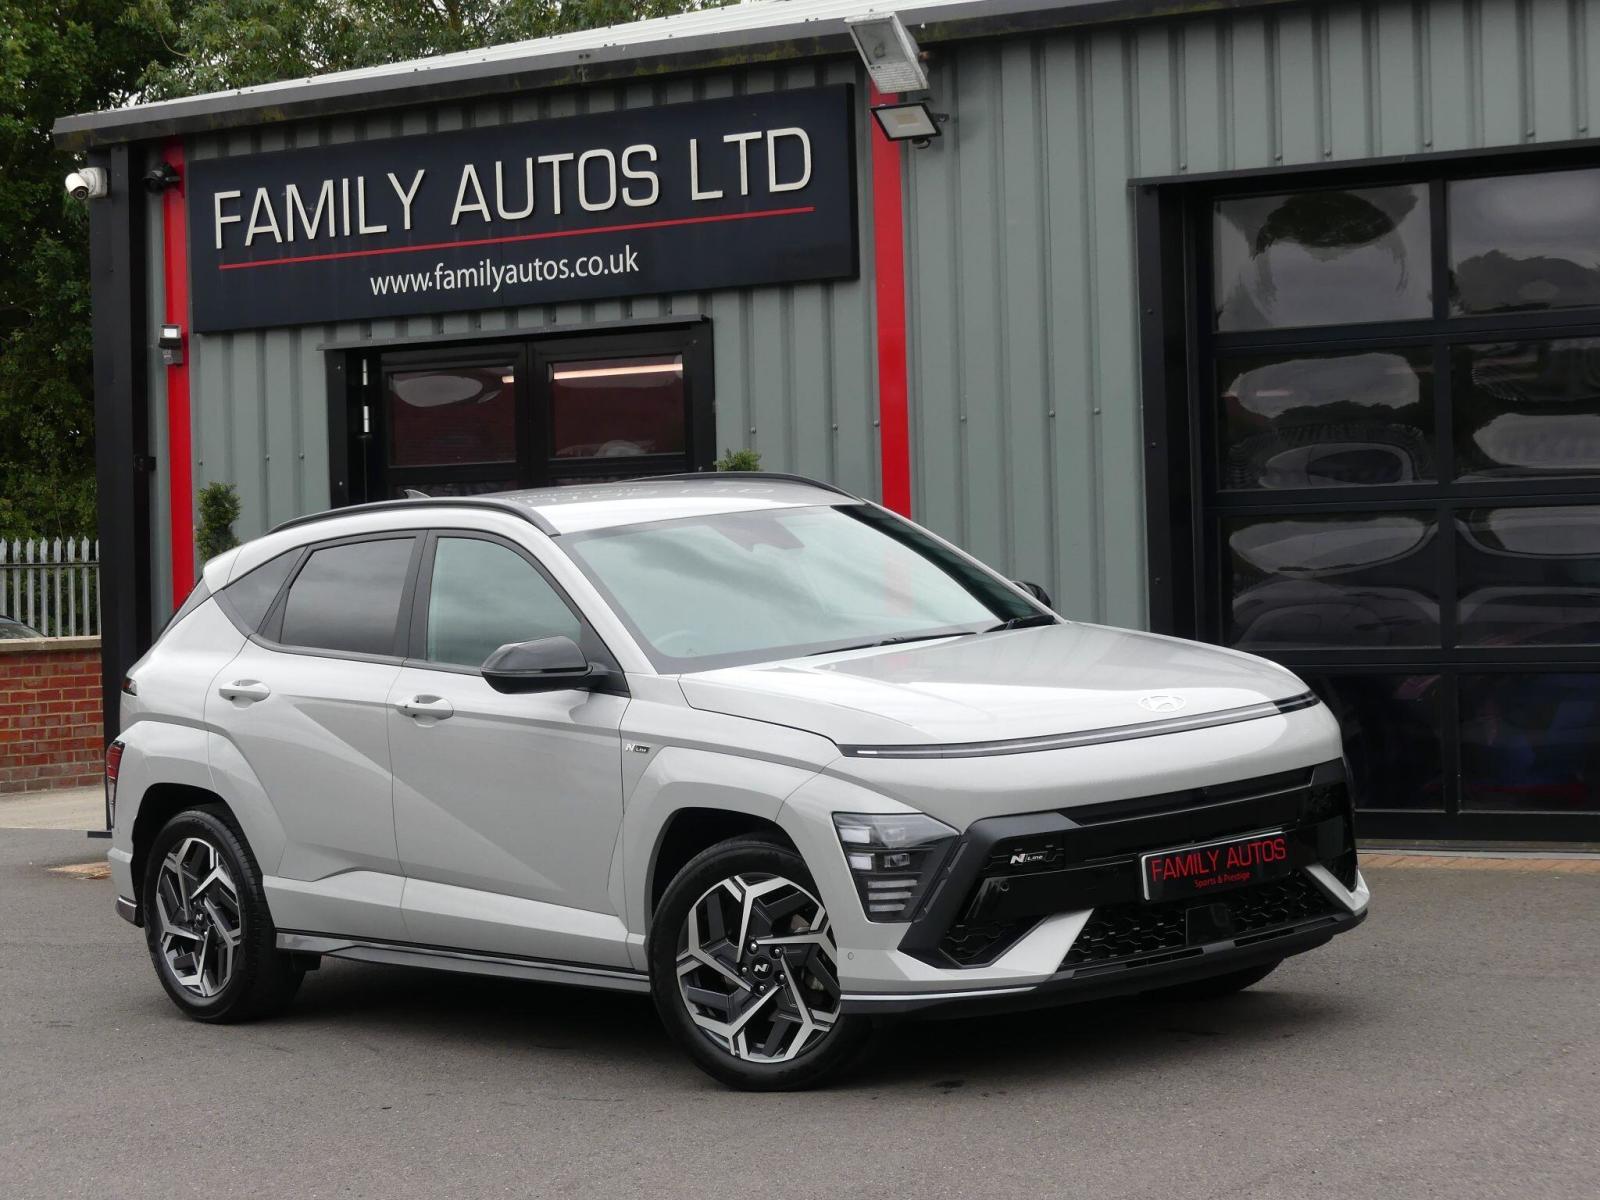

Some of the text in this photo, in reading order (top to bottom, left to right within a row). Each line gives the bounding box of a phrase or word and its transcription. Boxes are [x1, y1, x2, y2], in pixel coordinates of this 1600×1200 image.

[214, 126, 812, 249] FAMILY AUTOS LTD
[369, 244, 640, 295] www.familyautos.co.uk
[1151, 837, 1287, 882] FAMILY AUTOS
[1193, 871, 1251, 889] Sports & Prestige
